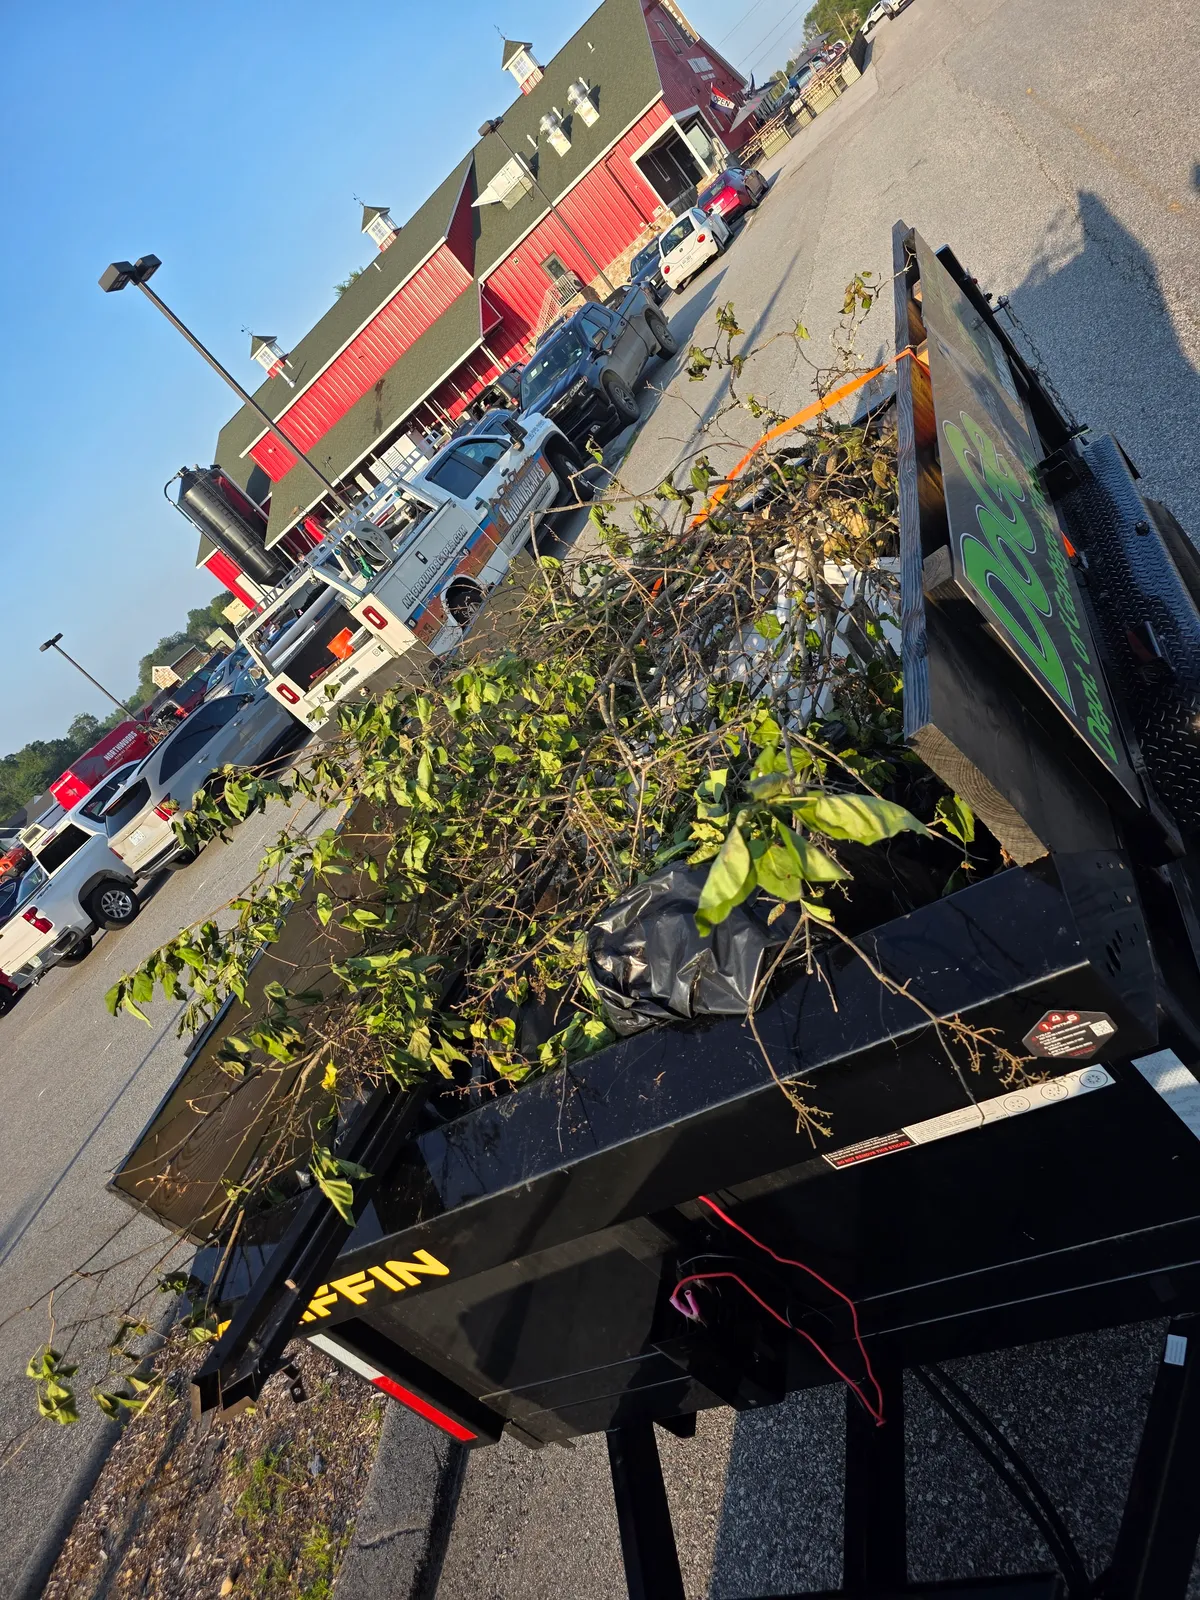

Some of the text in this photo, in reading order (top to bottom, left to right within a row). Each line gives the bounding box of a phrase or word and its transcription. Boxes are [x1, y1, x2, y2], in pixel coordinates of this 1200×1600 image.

[714, 95, 731, 107] OPEN
[499, 461, 546, 526] GROUNDSCAPES
[1058, 610, 1091, 665] of
[1072, 661, 1118, 765] Dept.
[103, 730, 138, 761] NORTHWOODS
